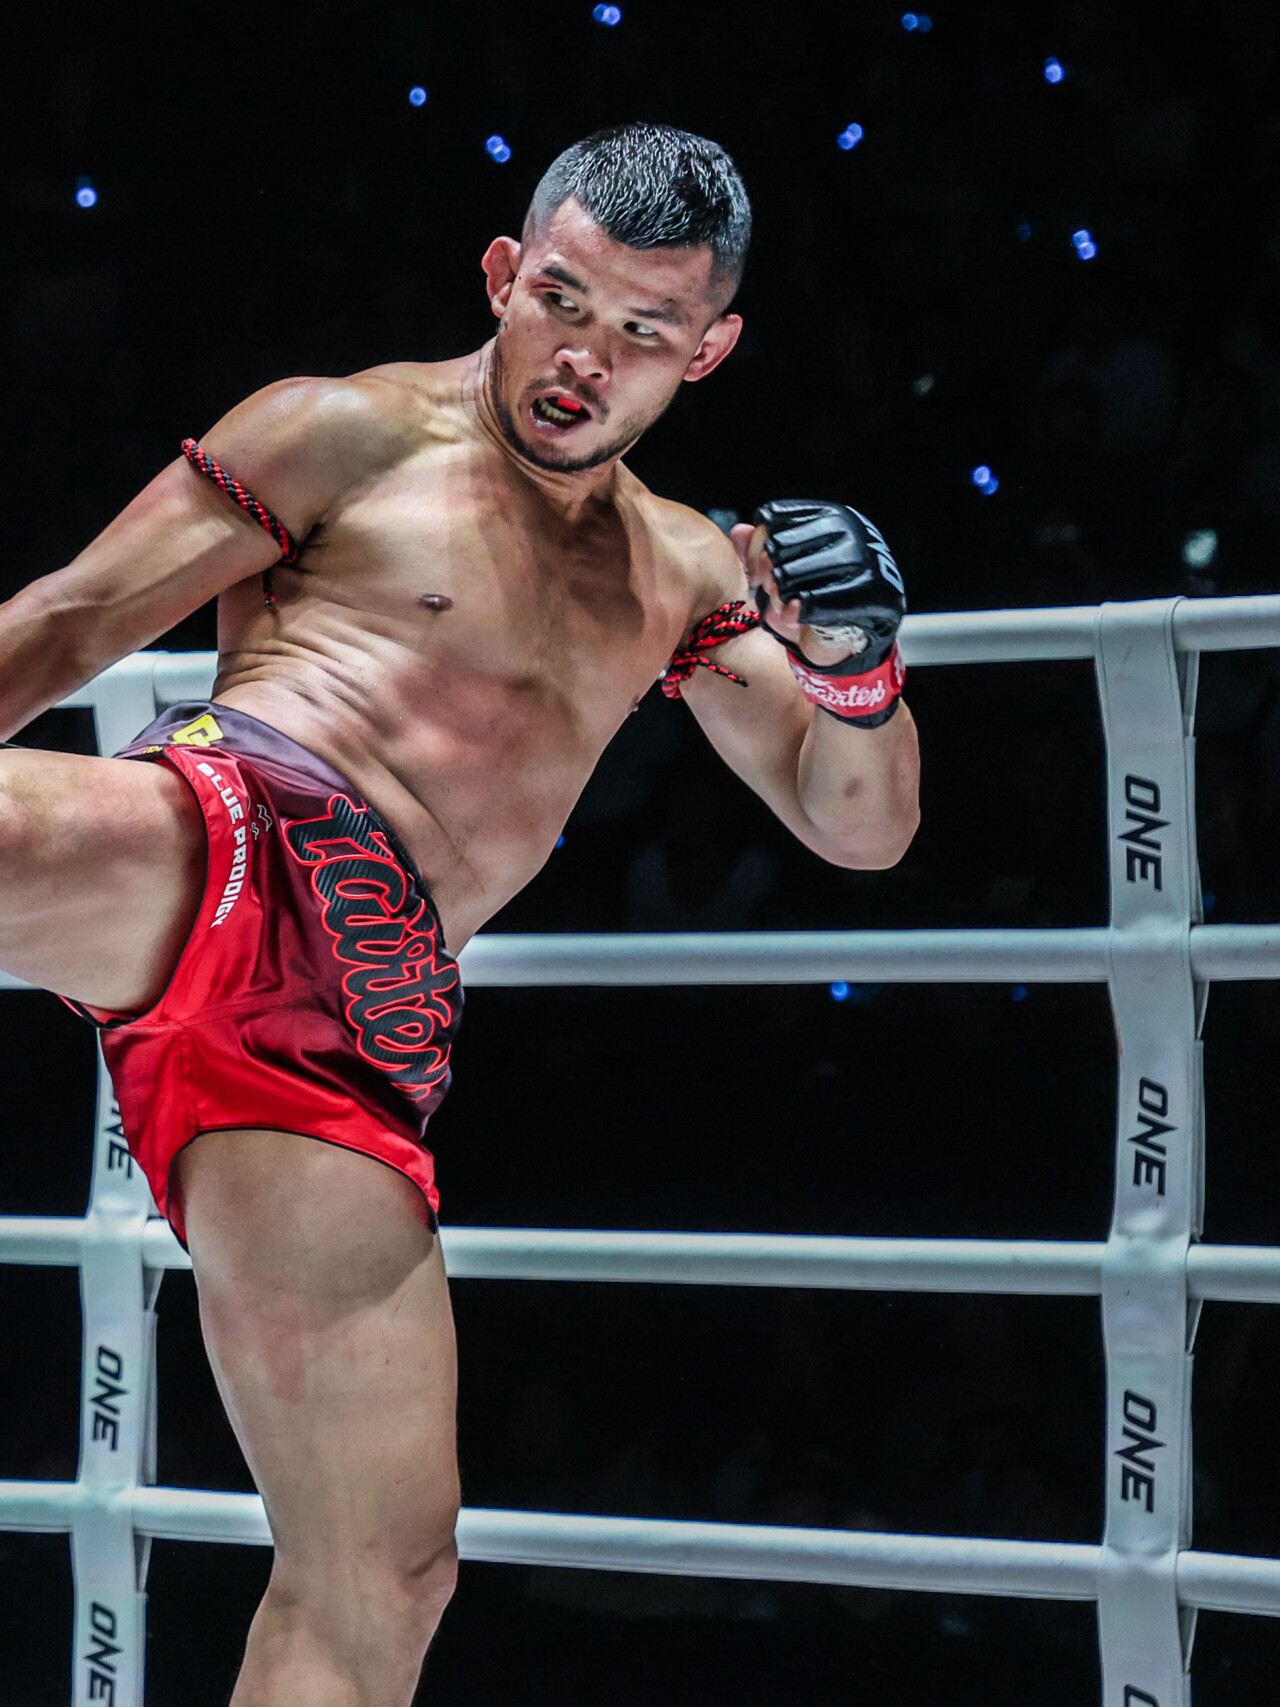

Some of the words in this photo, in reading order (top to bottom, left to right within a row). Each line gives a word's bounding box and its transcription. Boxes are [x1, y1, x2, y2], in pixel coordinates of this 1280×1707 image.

[196, 763, 245, 825] BLUE
[1117, 773, 1172, 891] ONE
[211, 826, 247, 929] PRODIGY
[105, 1107, 133, 1180] NE
[1127, 1075, 1178, 1197] ONE
[86, 1345, 131, 1452] ONE
[1114, 1389, 1167, 1514] ONE
[82, 1602, 127, 1707] ONE
